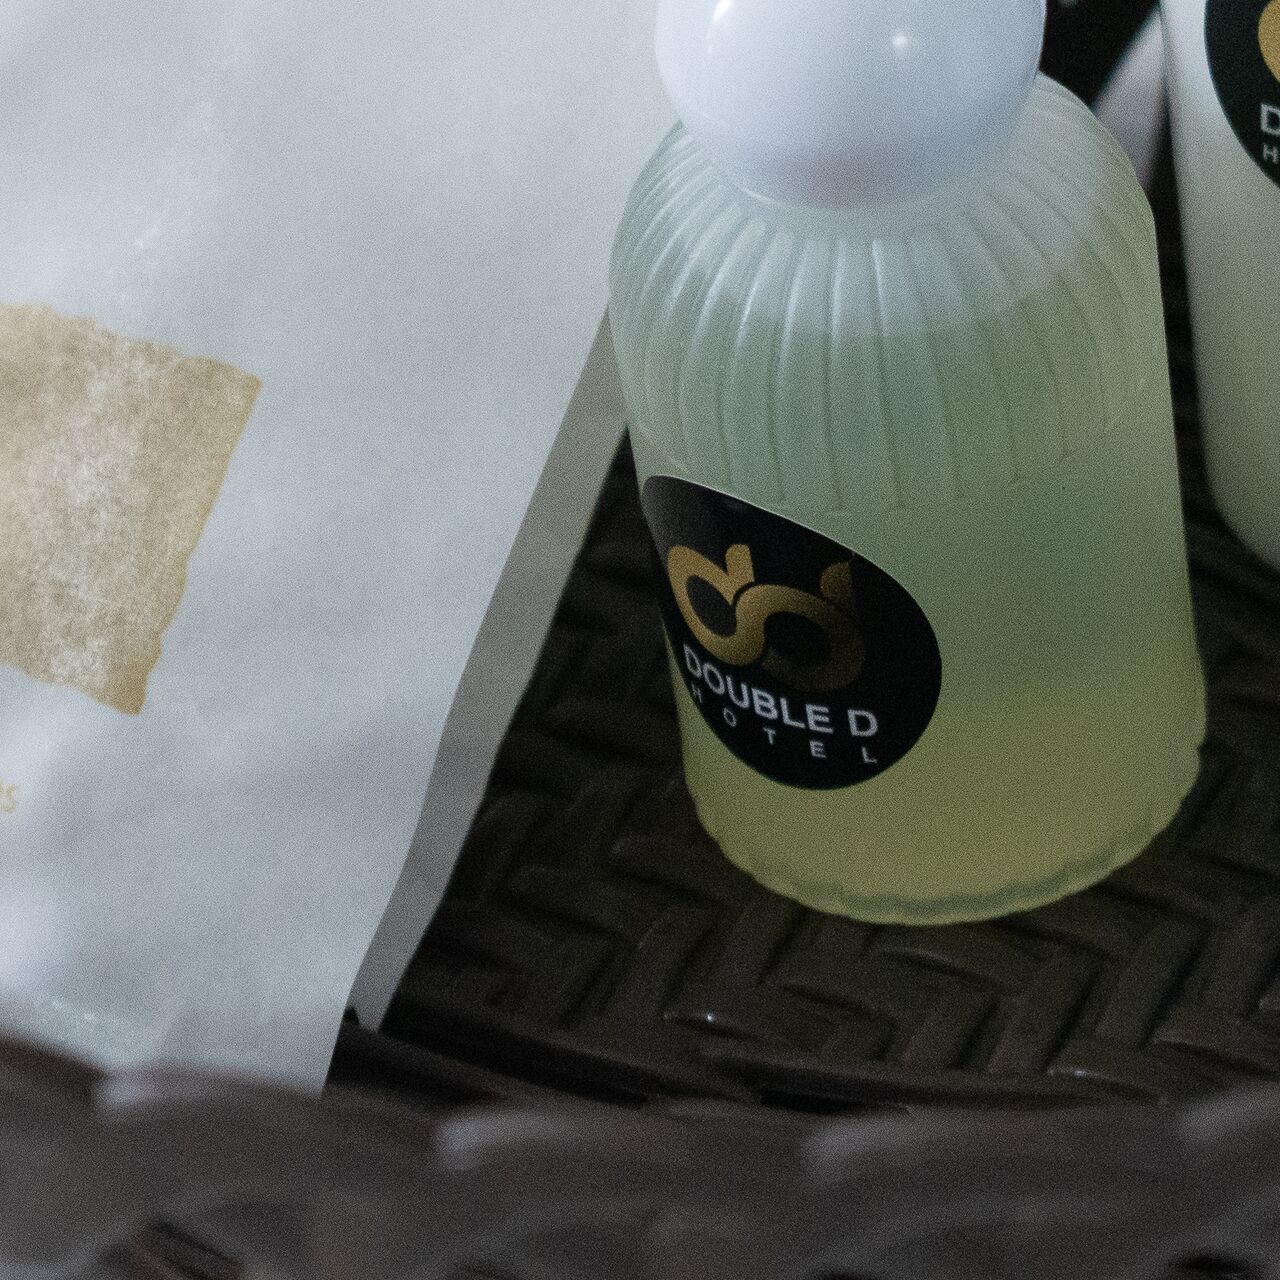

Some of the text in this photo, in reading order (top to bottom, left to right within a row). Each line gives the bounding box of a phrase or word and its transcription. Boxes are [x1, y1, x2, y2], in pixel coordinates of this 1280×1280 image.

[683, 643, 879, 738] DOUBLE D
[691, 680, 878, 764] HOTEL
